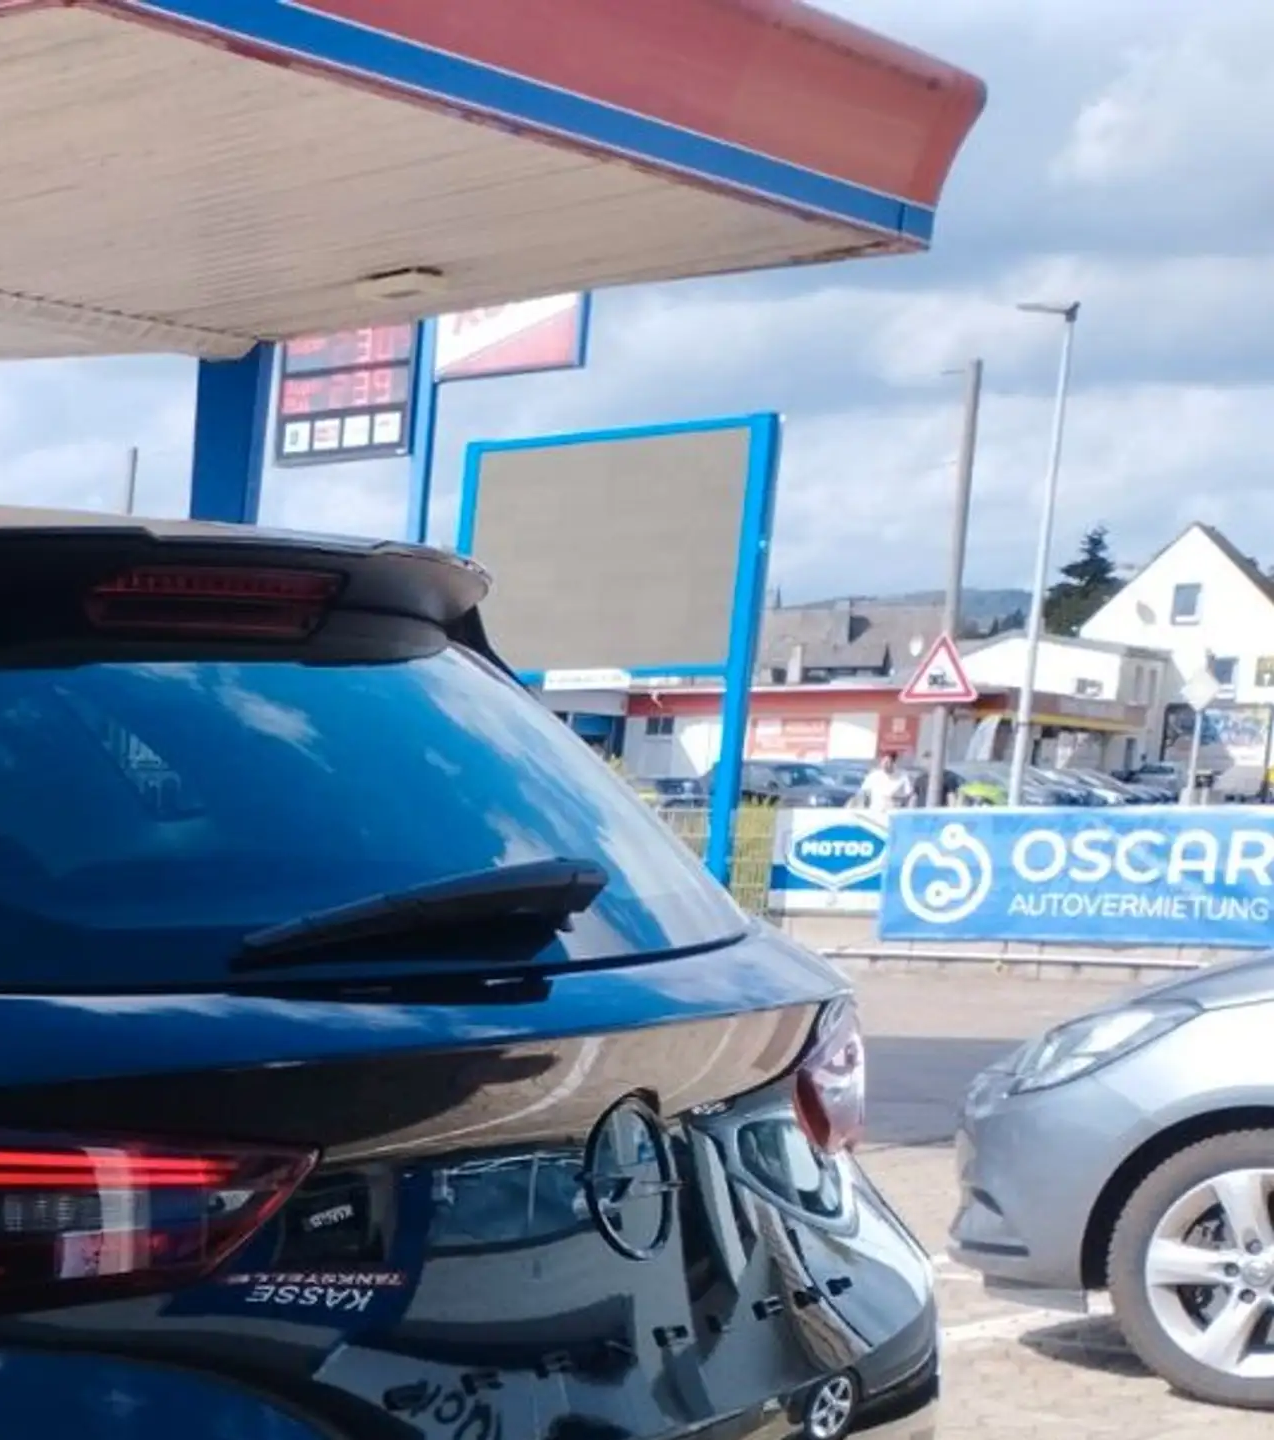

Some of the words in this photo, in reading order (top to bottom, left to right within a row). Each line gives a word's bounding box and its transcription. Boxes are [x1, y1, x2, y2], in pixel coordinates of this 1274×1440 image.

[1011, 828, 1274, 886] OSCAR
[1007, 892, 1270, 921] AUTOVERMIETUNG
[245, 1284, 374, 1312] KASSE
